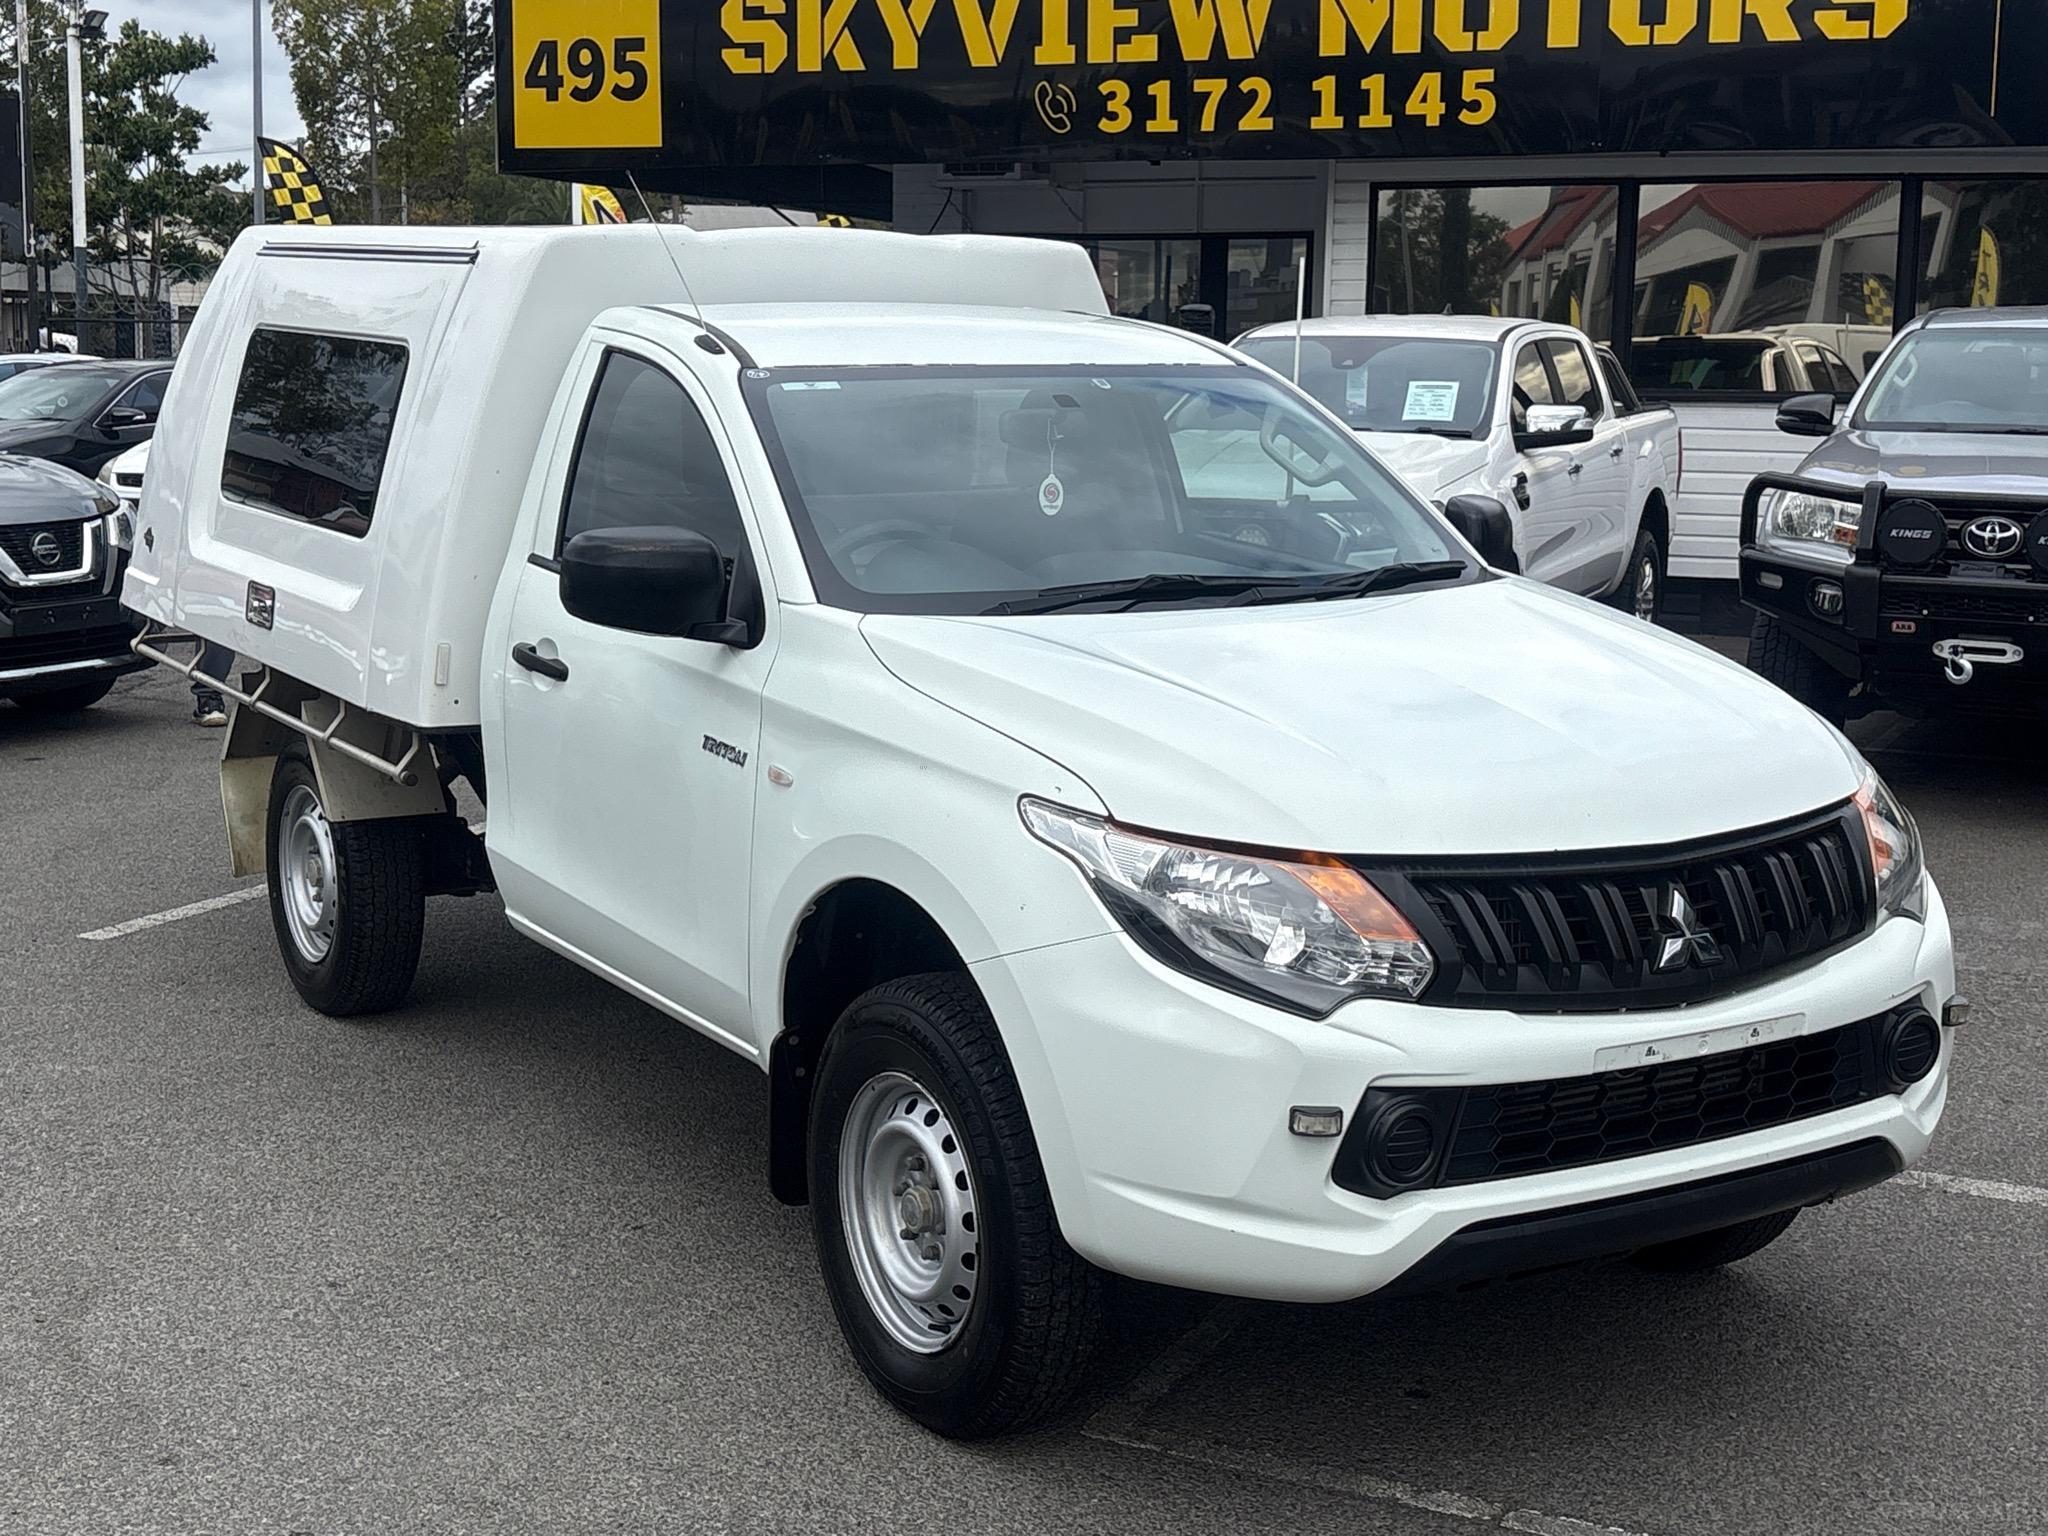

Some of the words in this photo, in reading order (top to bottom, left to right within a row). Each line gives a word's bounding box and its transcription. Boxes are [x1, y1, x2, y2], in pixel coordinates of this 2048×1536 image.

[720, 0, 1274, 74] SKYVIEW
[523, 37, 650, 103] 495
[1097, 77, 1275, 134] 3172
[1309, 69, 1497, 130] 1145
[1890, 528, 1933, 539] KINGS
